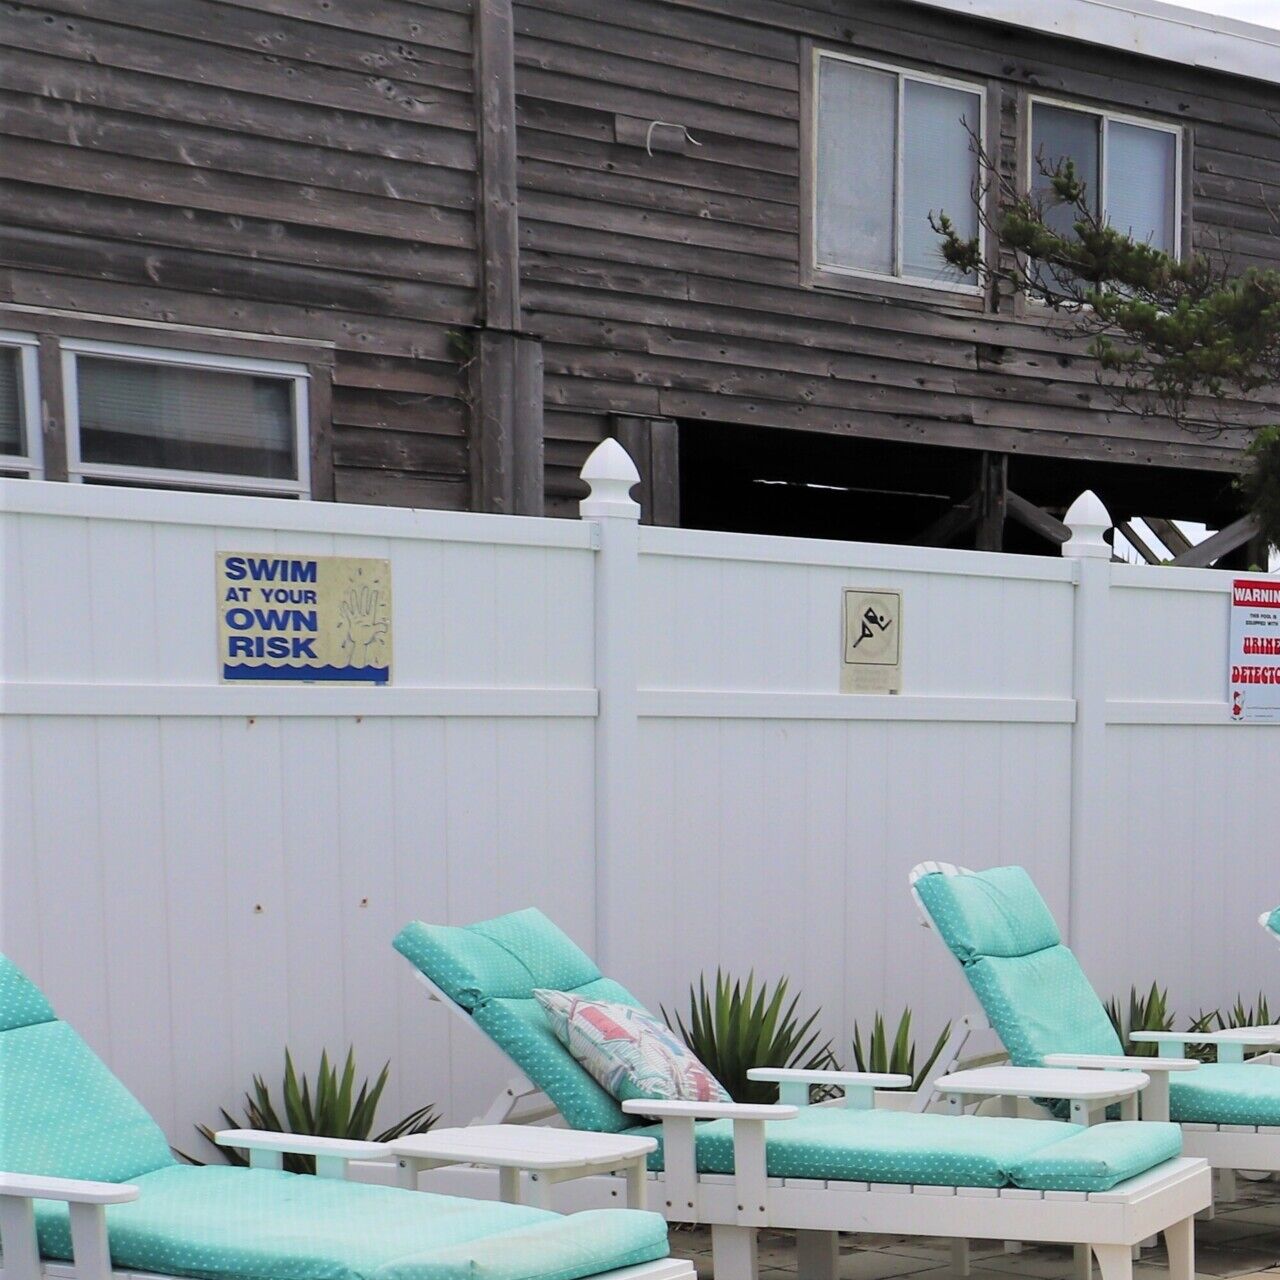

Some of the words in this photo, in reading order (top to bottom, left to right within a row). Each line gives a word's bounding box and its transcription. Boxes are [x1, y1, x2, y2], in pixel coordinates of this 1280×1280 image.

[225, 556, 318, 583] SWIM
[225, 587, 252, 602] AT
[261, 588, 317, 604] YOUR
[225, 607, 318, 632] OWN
[228, 636, 318, 659] RISK
[1243, 636, 1280, 655] URINE
